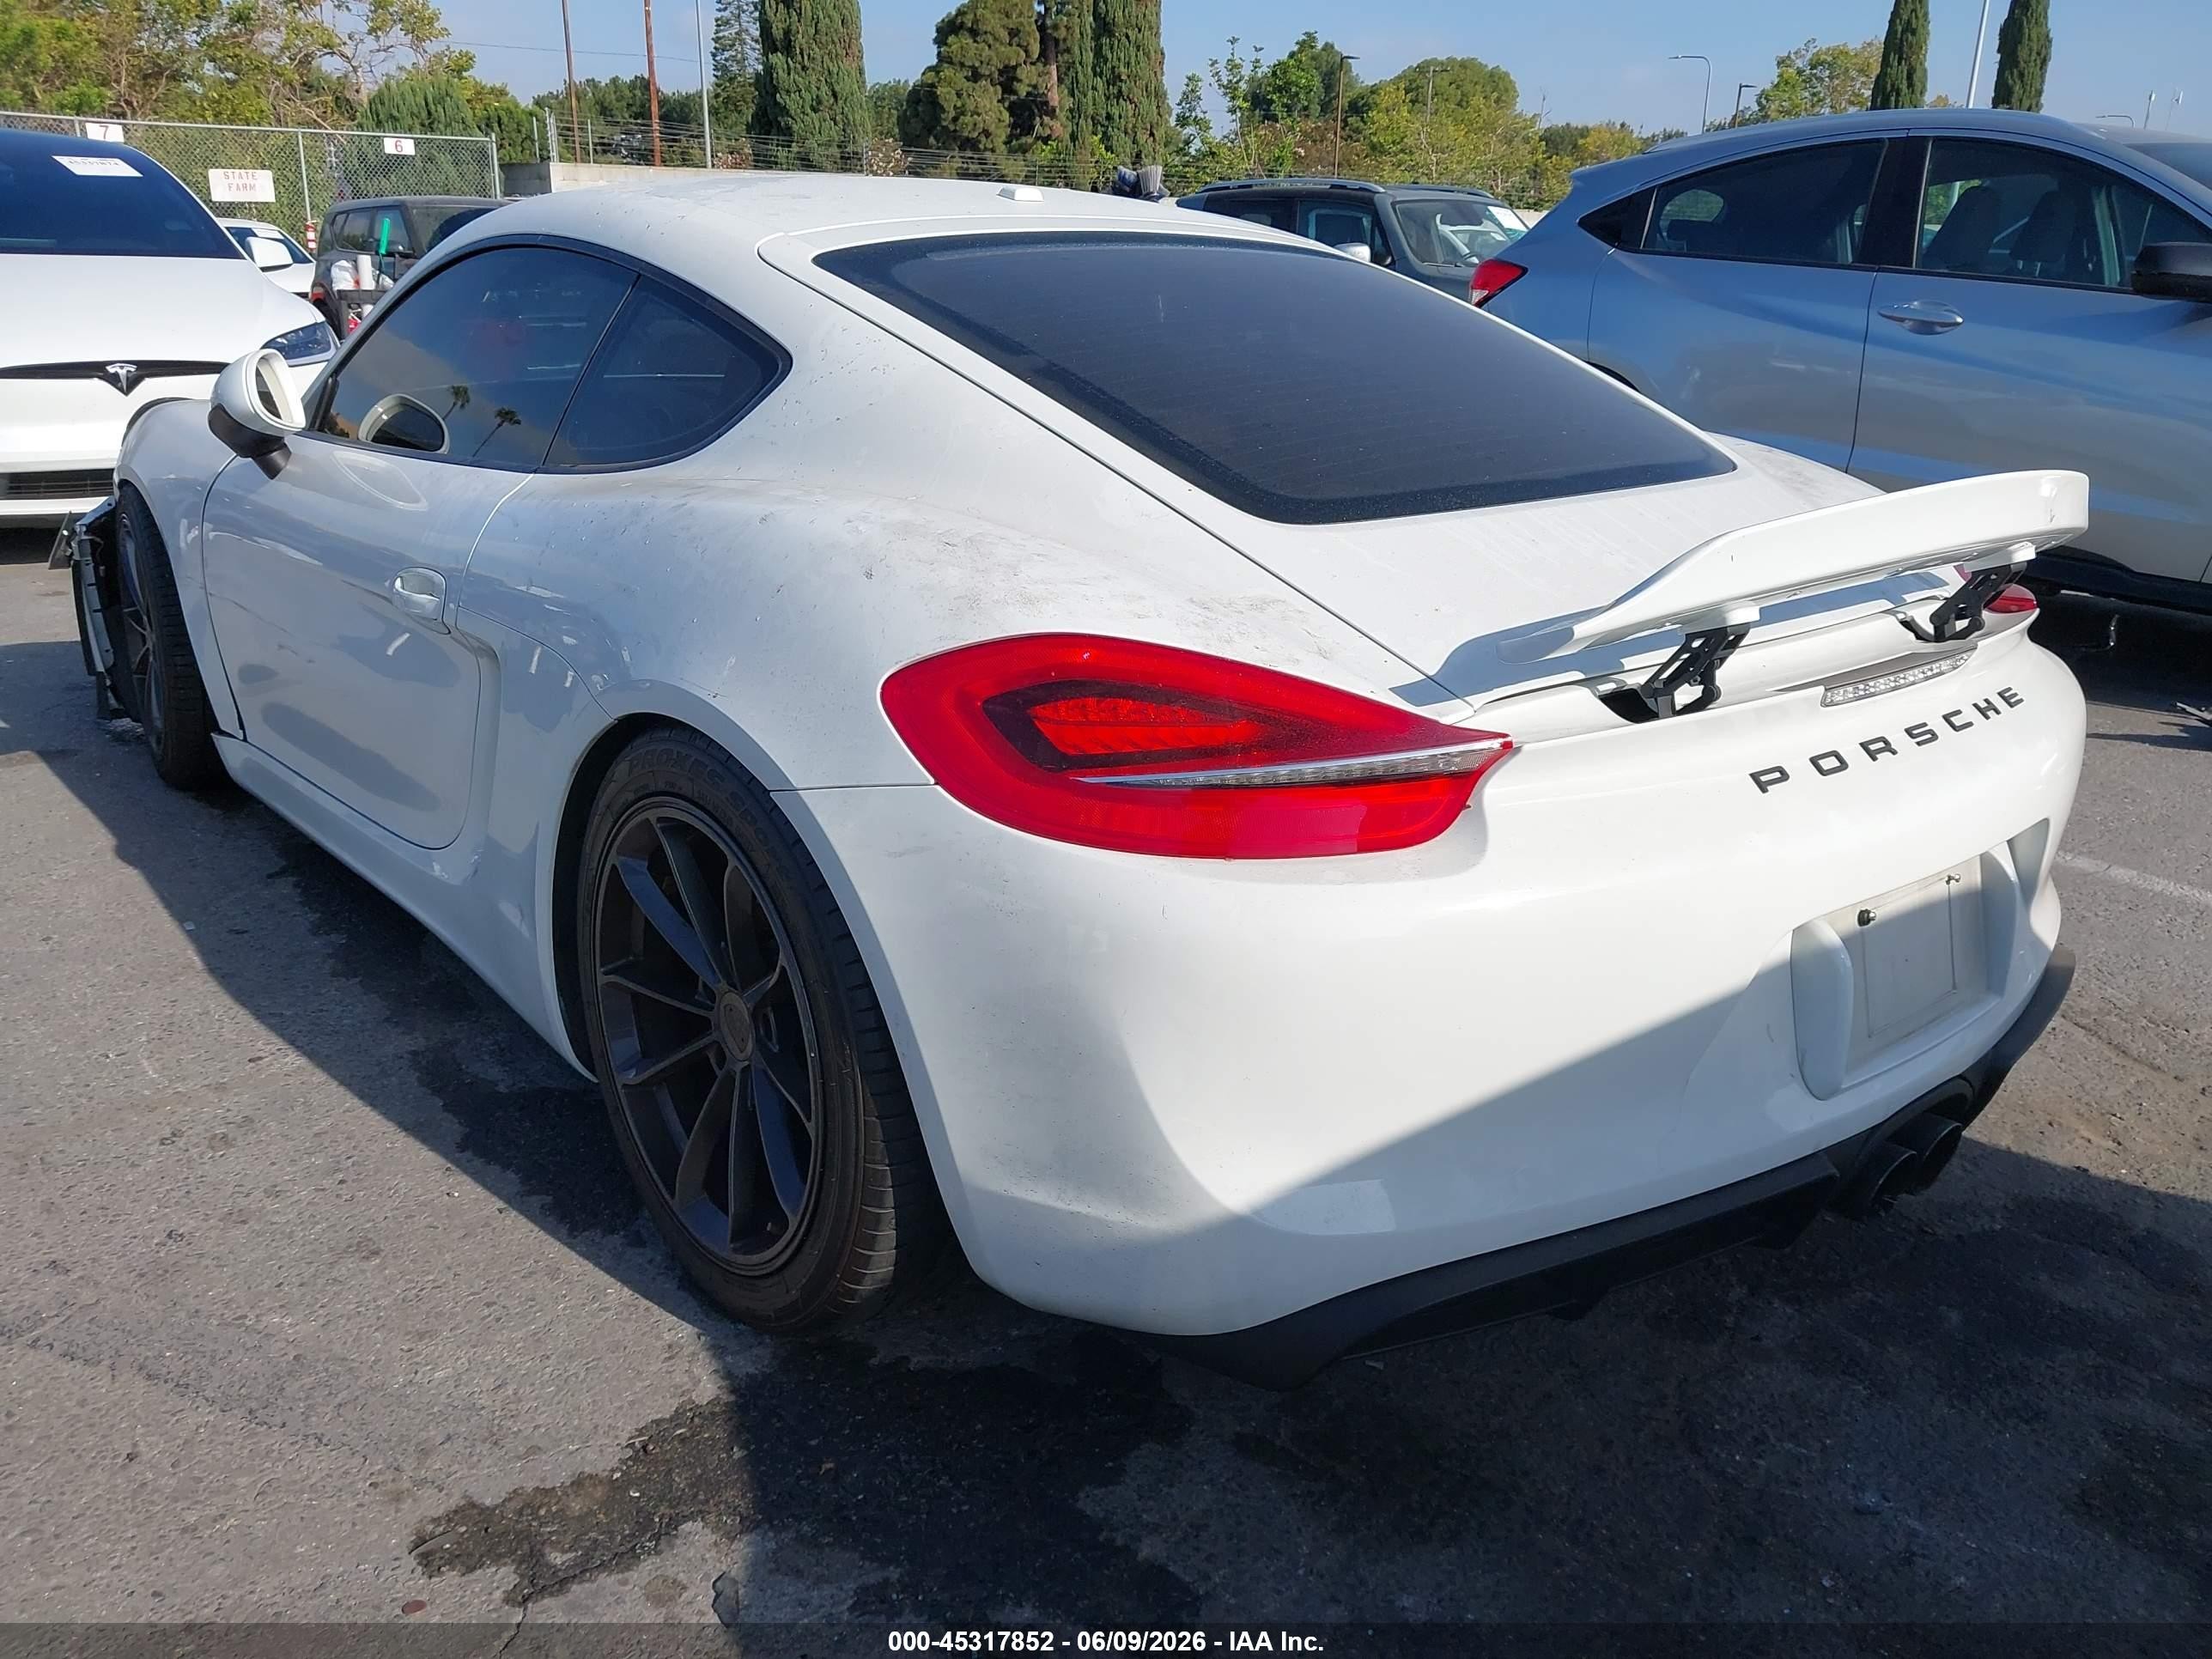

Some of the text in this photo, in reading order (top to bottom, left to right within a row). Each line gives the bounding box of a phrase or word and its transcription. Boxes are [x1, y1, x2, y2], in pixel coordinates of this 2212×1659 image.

[100, 125, 110, 140] 7
[395, 140, 403, 153] 6
[223, 171, 258, 181] STATE
[228, 183, 258, 192] FARM
[1748, 686, 2025, 794] PORSCHE
